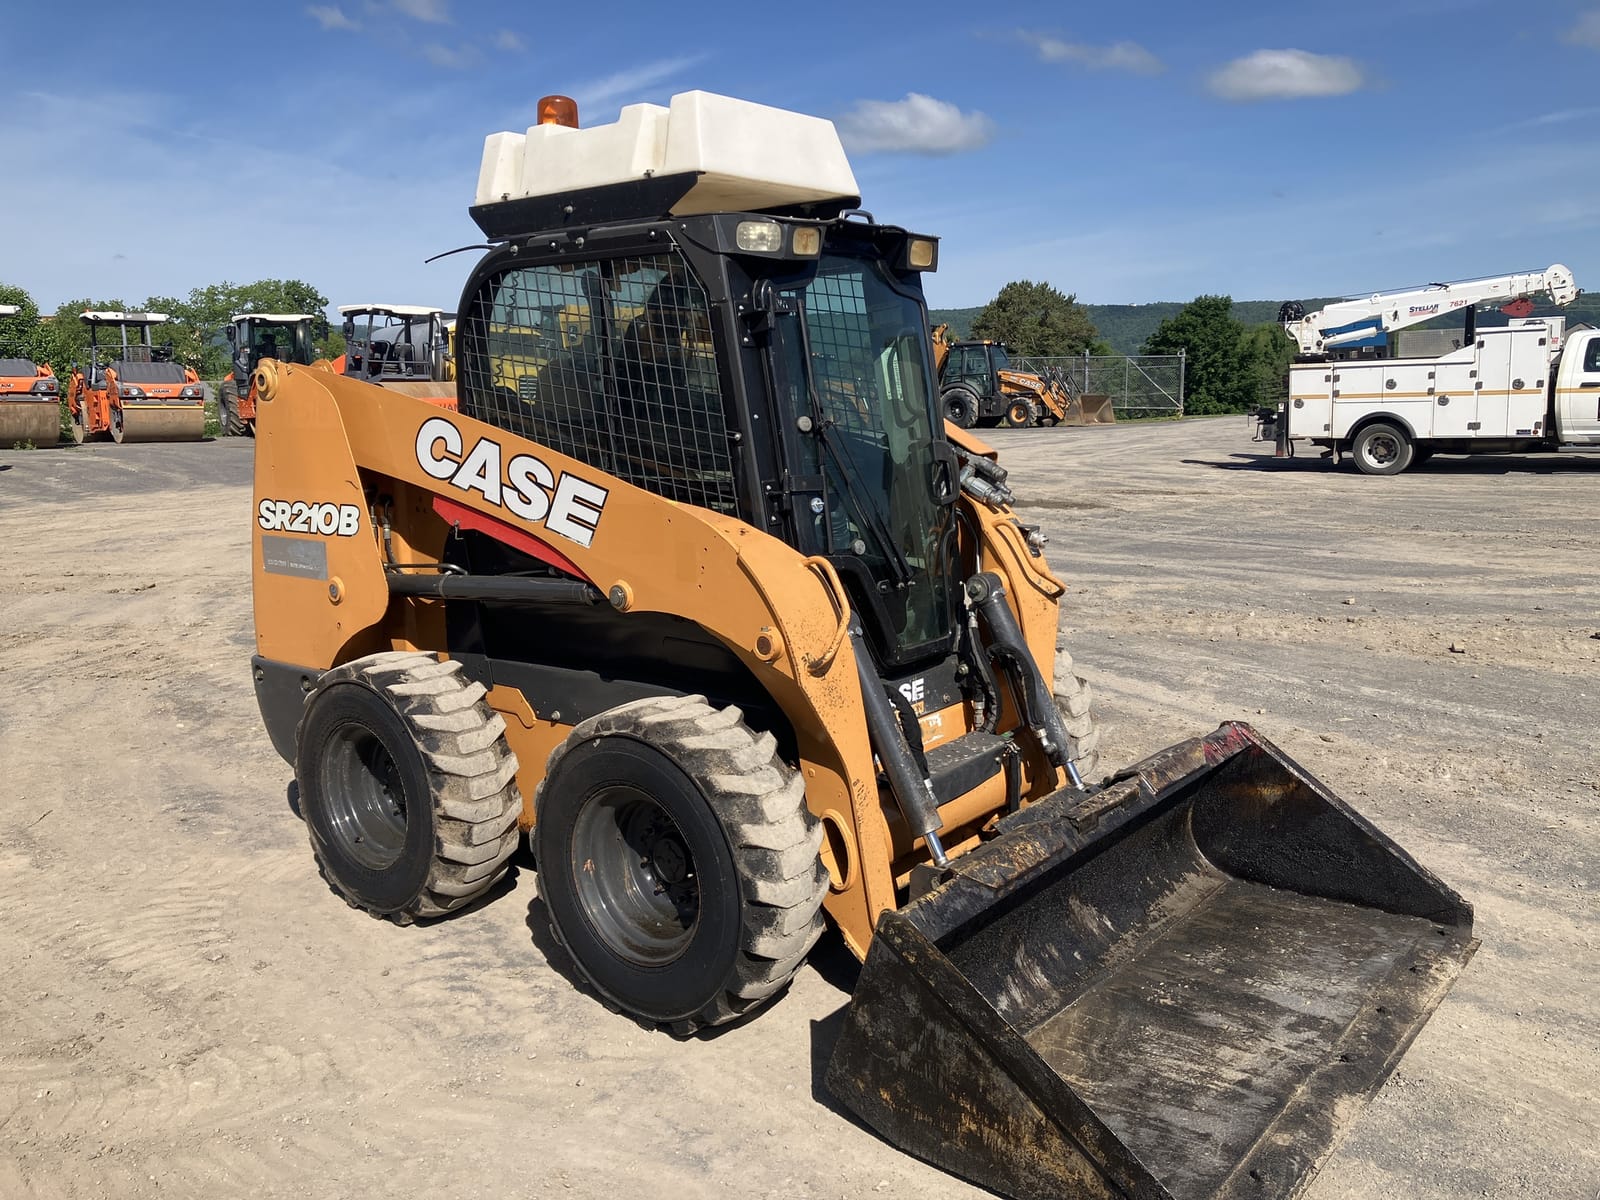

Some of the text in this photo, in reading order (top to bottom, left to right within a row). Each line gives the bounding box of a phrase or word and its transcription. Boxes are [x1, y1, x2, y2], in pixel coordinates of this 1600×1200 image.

[1409, 304, 1439, 313] STELLAR
[1019, 378, 1042, 389] CASE
[415, 416, 609, 548] CASE
[258, 498, 360, 537] SR210B
